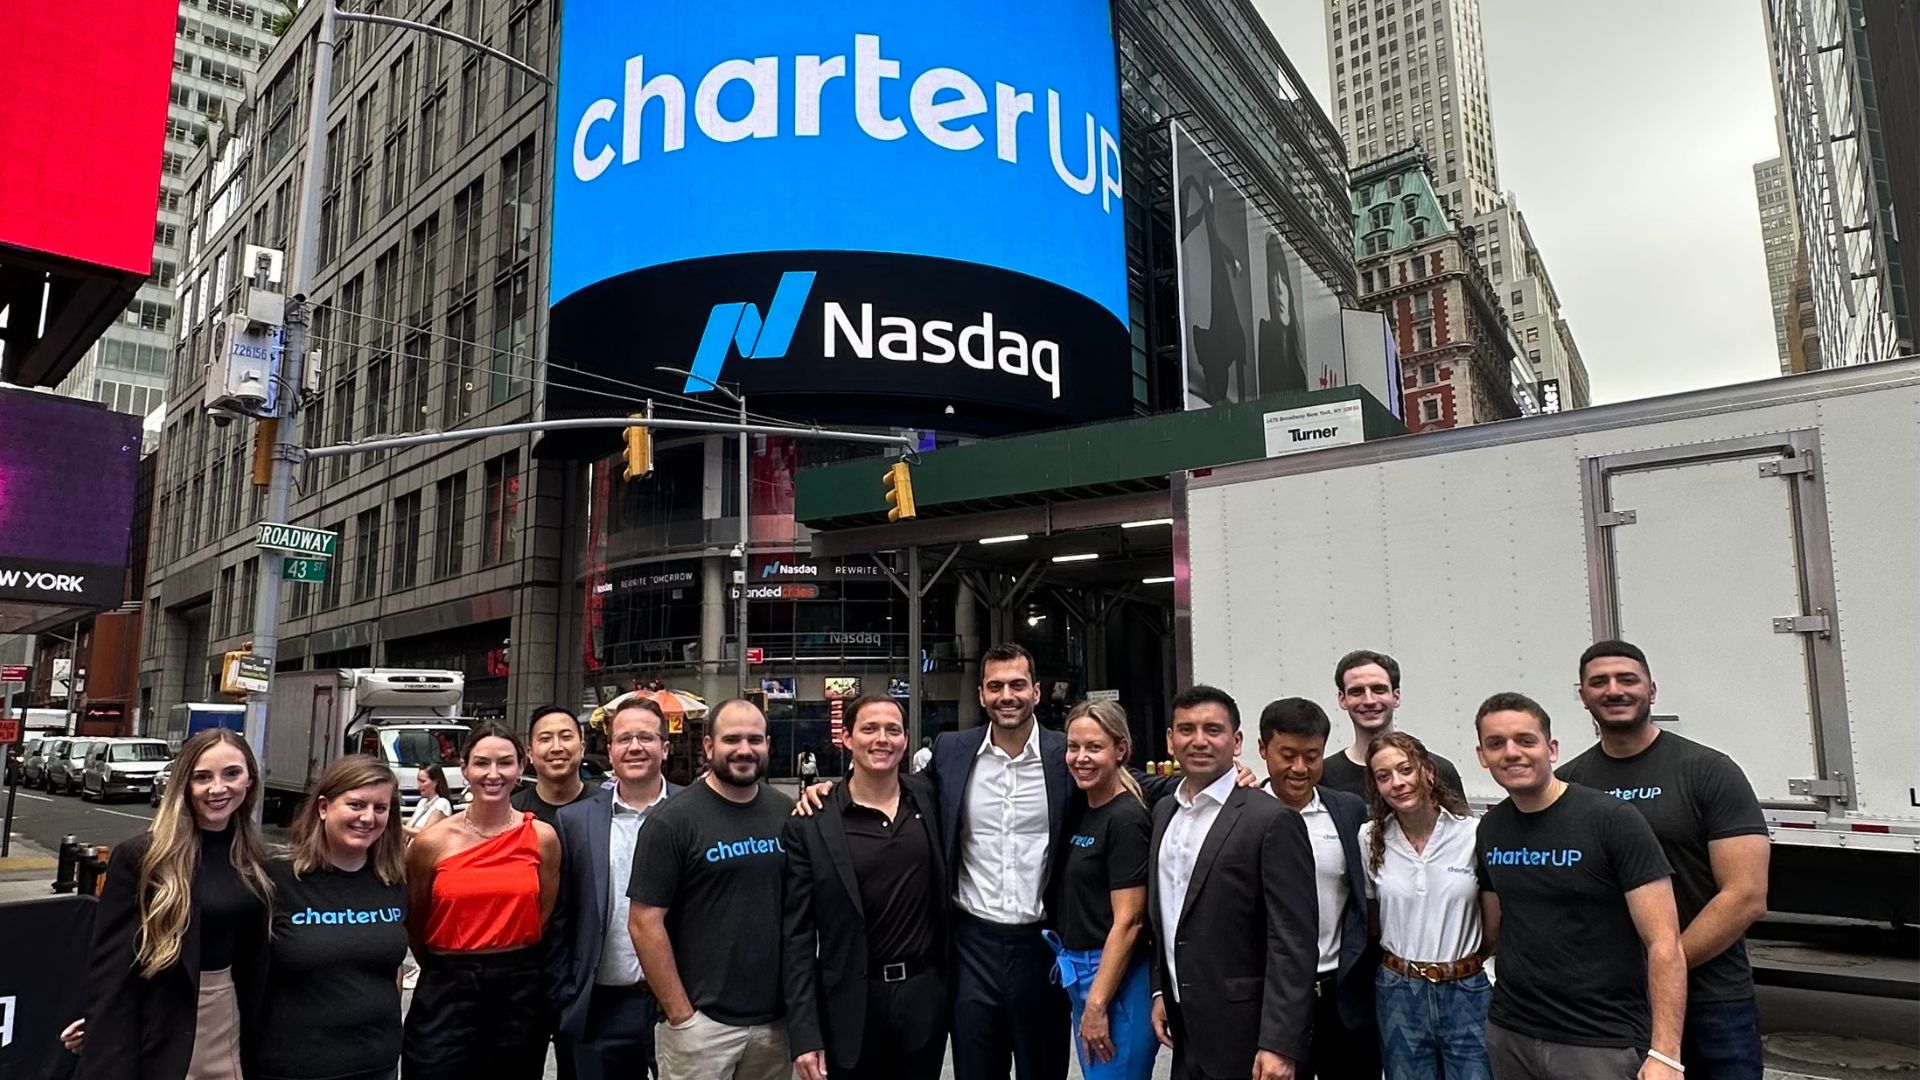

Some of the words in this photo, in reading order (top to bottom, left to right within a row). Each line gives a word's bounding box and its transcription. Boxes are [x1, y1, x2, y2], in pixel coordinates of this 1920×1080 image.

[572, 33, 1123, 214] charterUP
[823, 301, 1060, 399] Nasdaq
[1288, 426, 1338, 442] Turner
[256, 525, 332, 552] BROADWAY
[288, 560, 307, 578] 43
[313, 562, 323, 571] ST
[780, 563, 817, 576] Nasdaq
[835, 566, 878, 575] REWRITE
[23, 571, 84, 592] YORK
[830, 631, 881, 646] Nasdaq
[1604, 786, 1662, 801] terUP
[291, 907, 401, 925] charterUP
